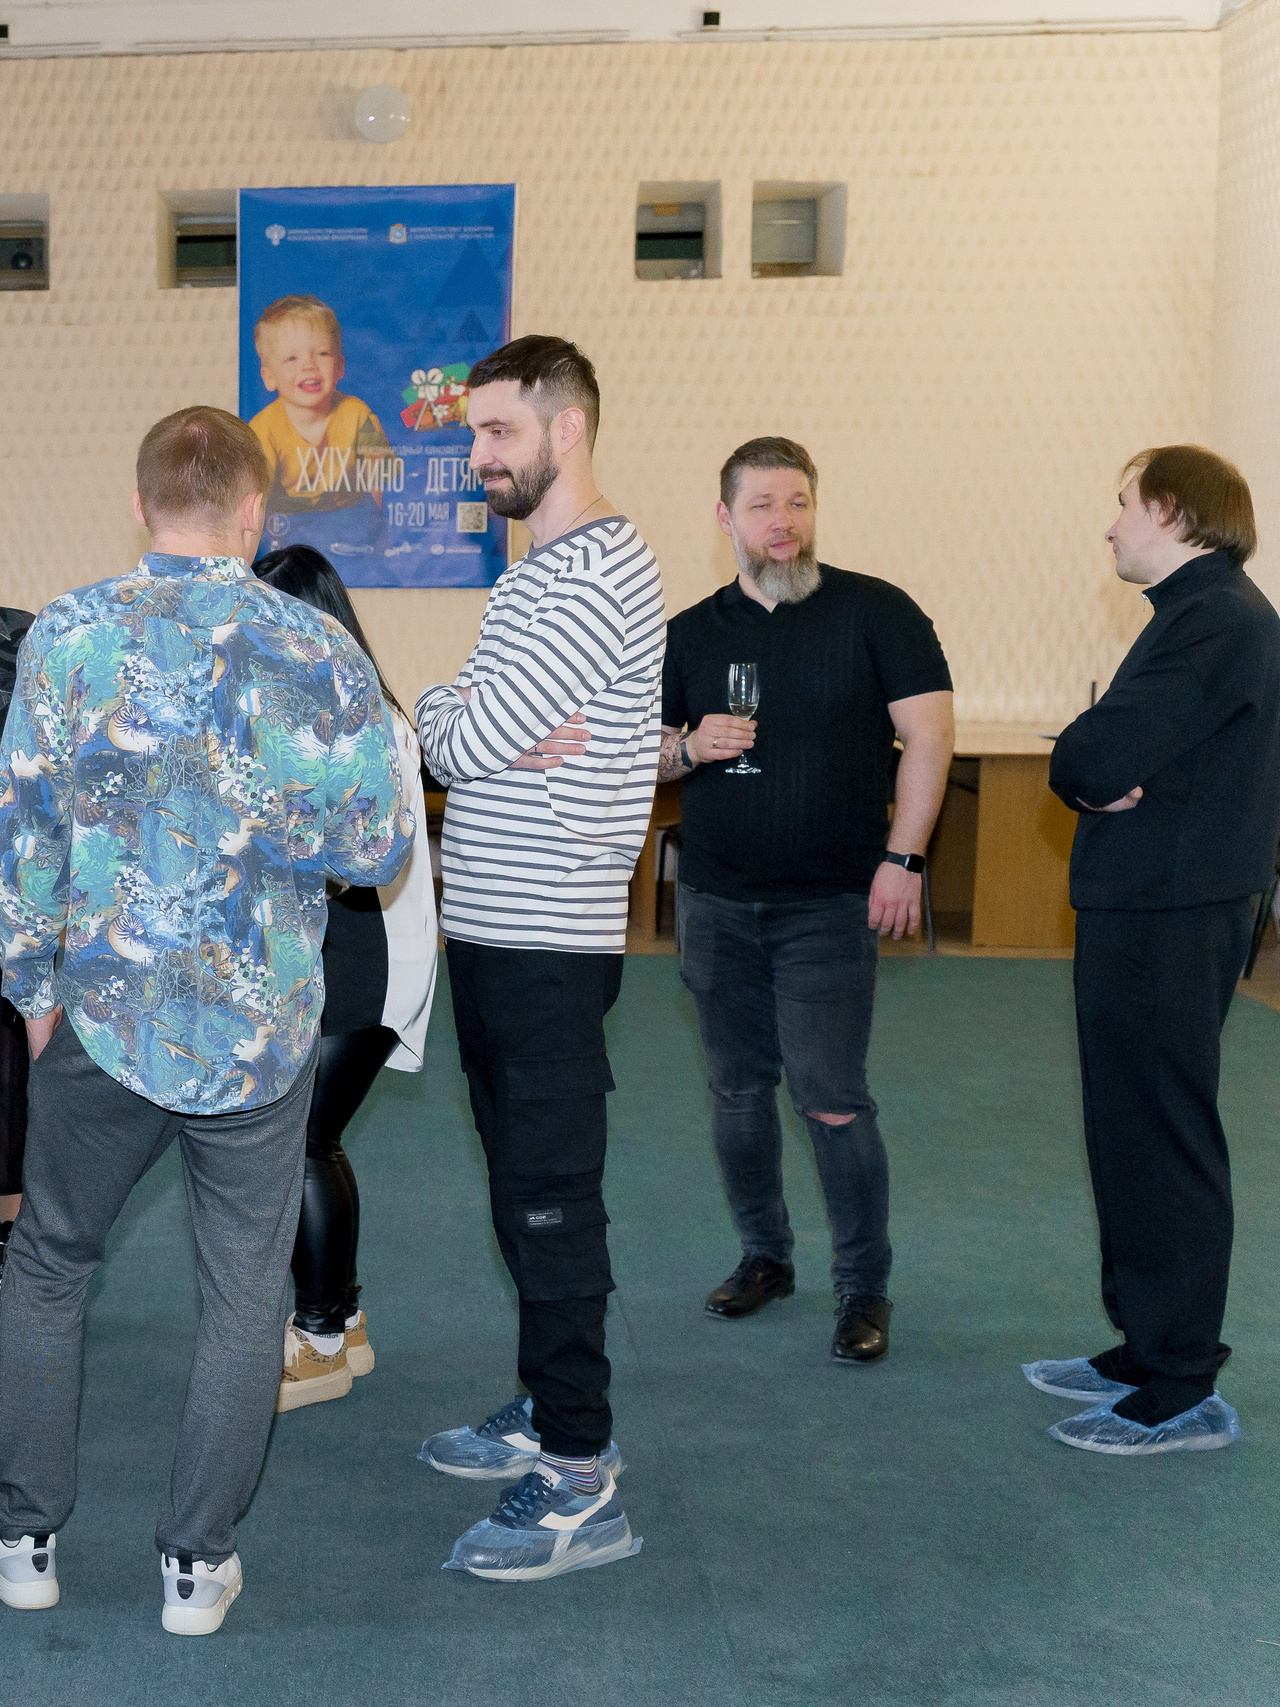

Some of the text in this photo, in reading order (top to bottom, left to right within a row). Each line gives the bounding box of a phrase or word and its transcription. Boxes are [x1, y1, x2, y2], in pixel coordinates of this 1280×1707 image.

[295, 446, 352, 493] XXIX
[355, 457, 405, 493] КИНО
[387, 502, 425, 527] 16-20
[428, 501, 450, 521] МАЯ
